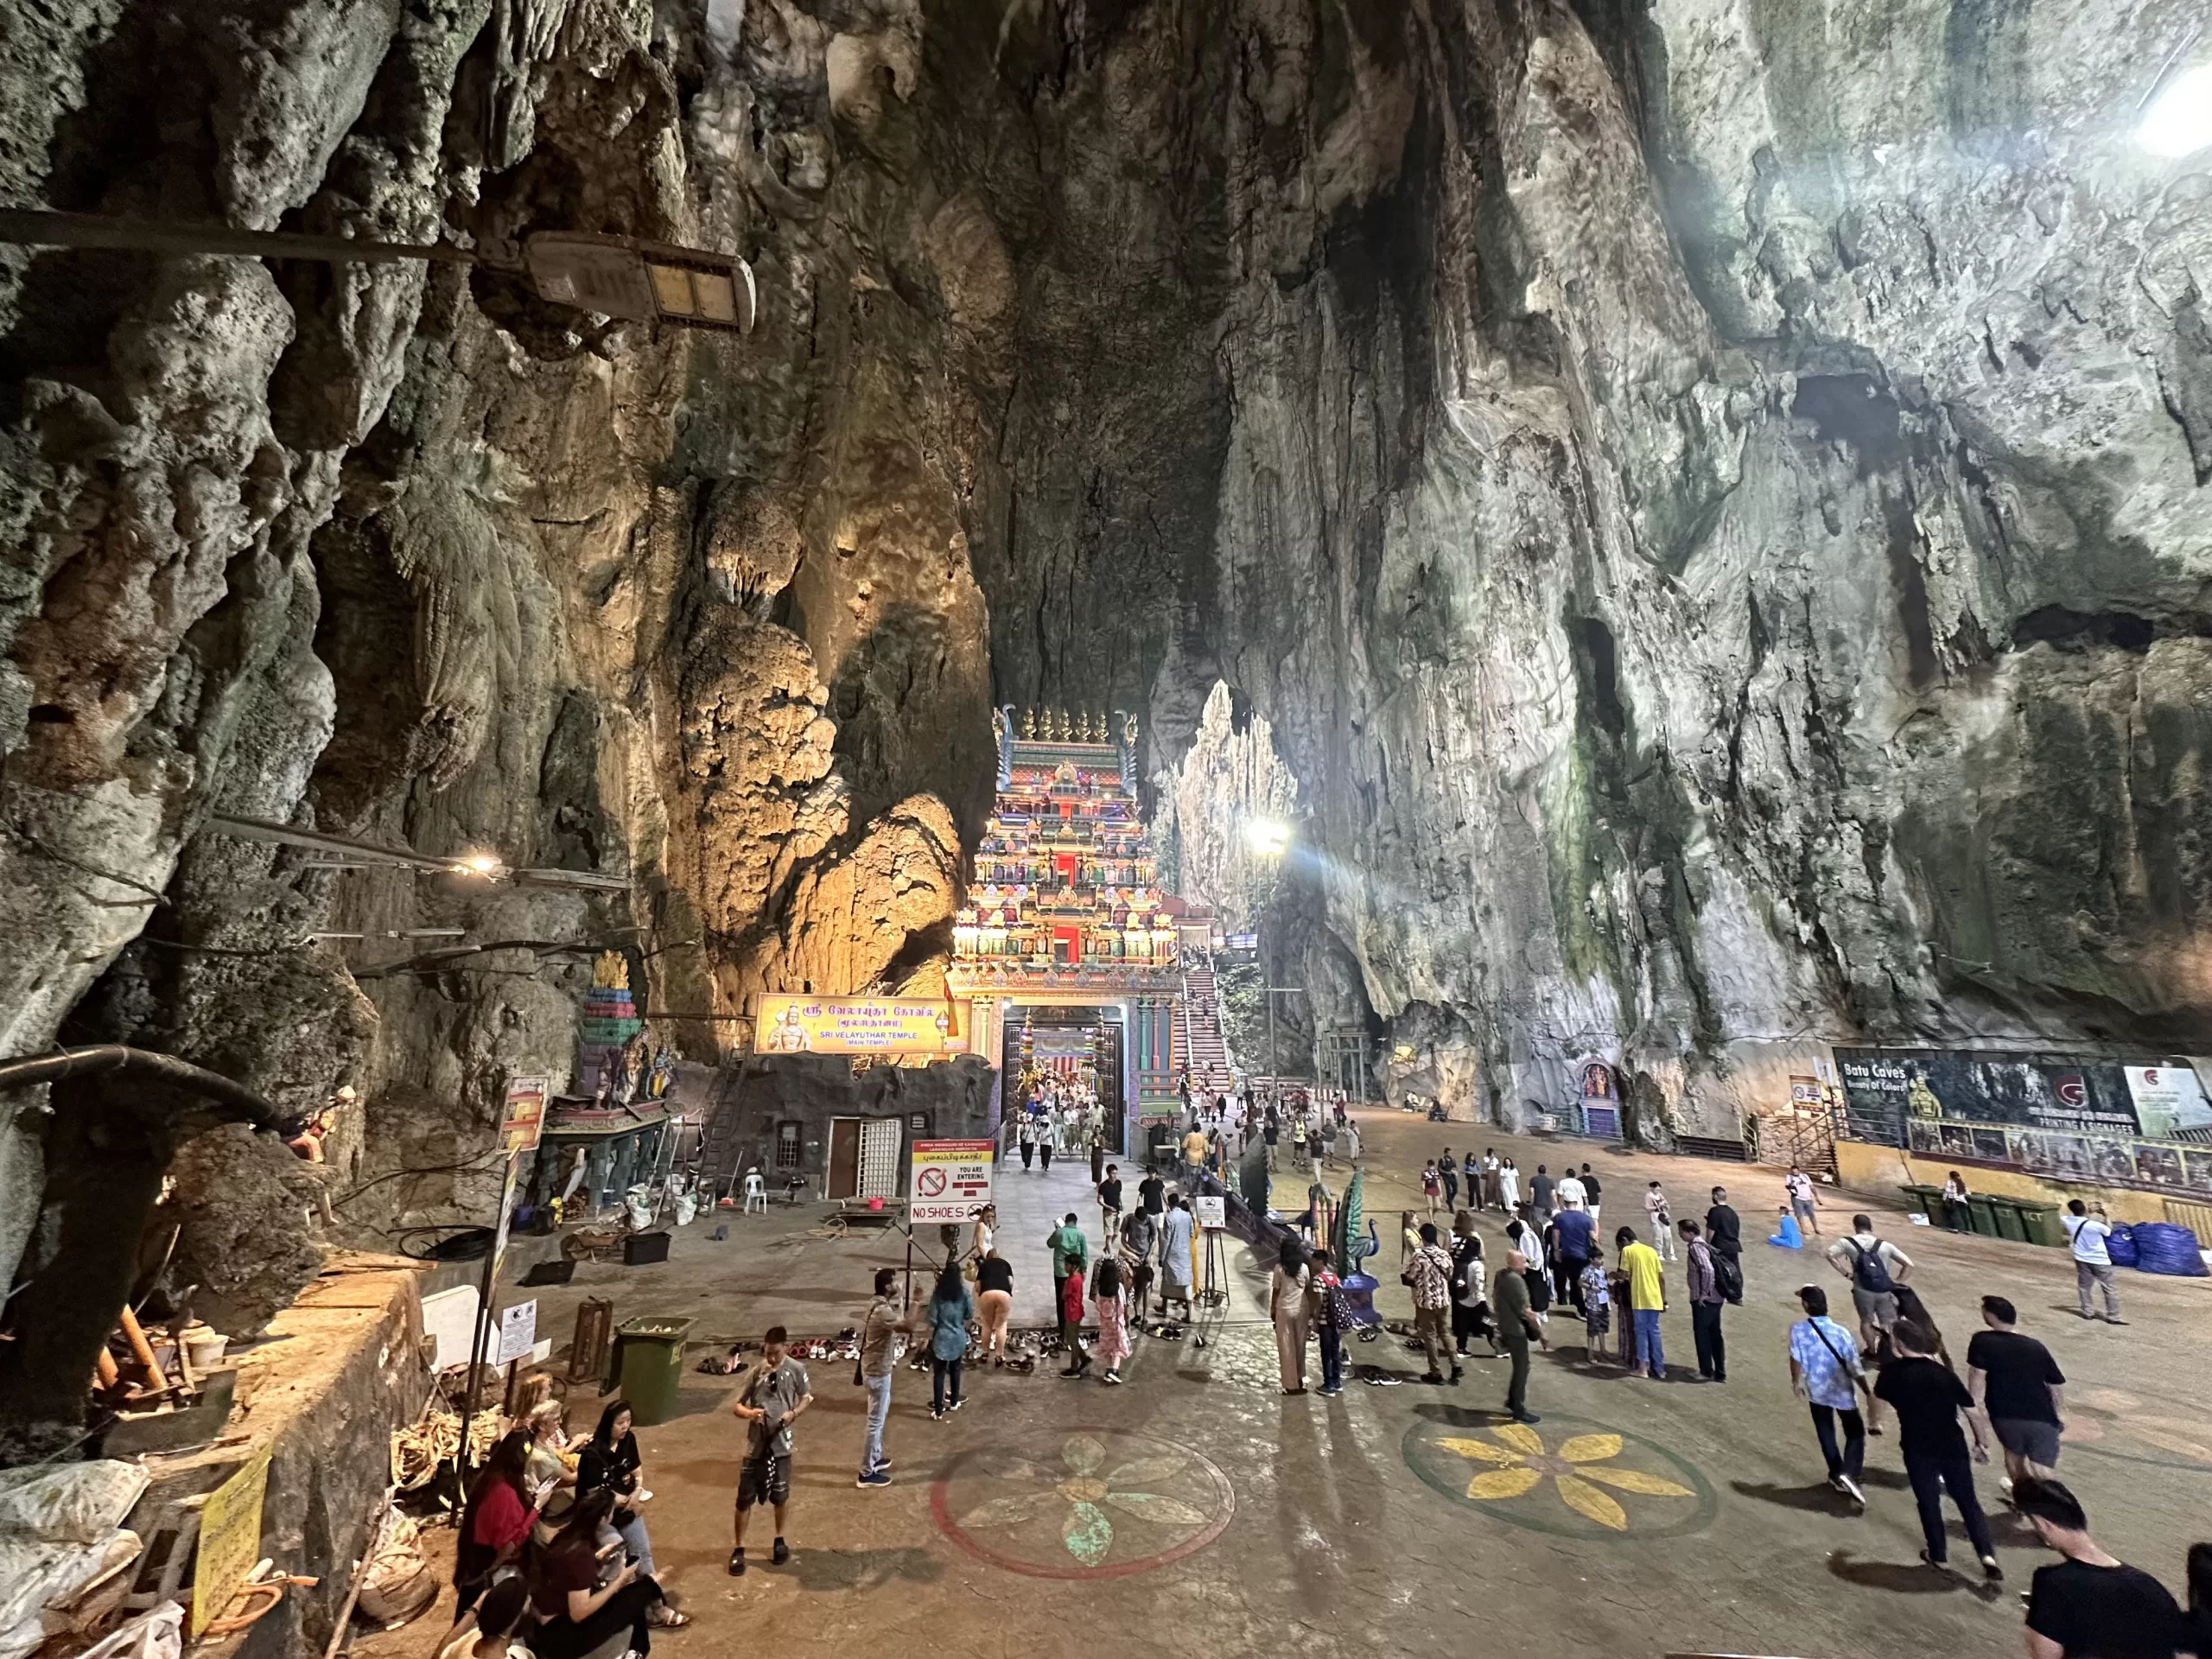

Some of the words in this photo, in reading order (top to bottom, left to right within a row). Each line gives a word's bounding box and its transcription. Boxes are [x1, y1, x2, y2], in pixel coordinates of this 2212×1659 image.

[1843, 1063, 1869, 1077] Batu
[2039, 1117, 2078, 1129] PRINTING
[2080, 1121, 2087, 1131] &
[2089, 1122, 2135, 1135] SIGNAGES
[912, 1207, 925, 1217] NO
[927, 1207, 964, 1217] SHOES
